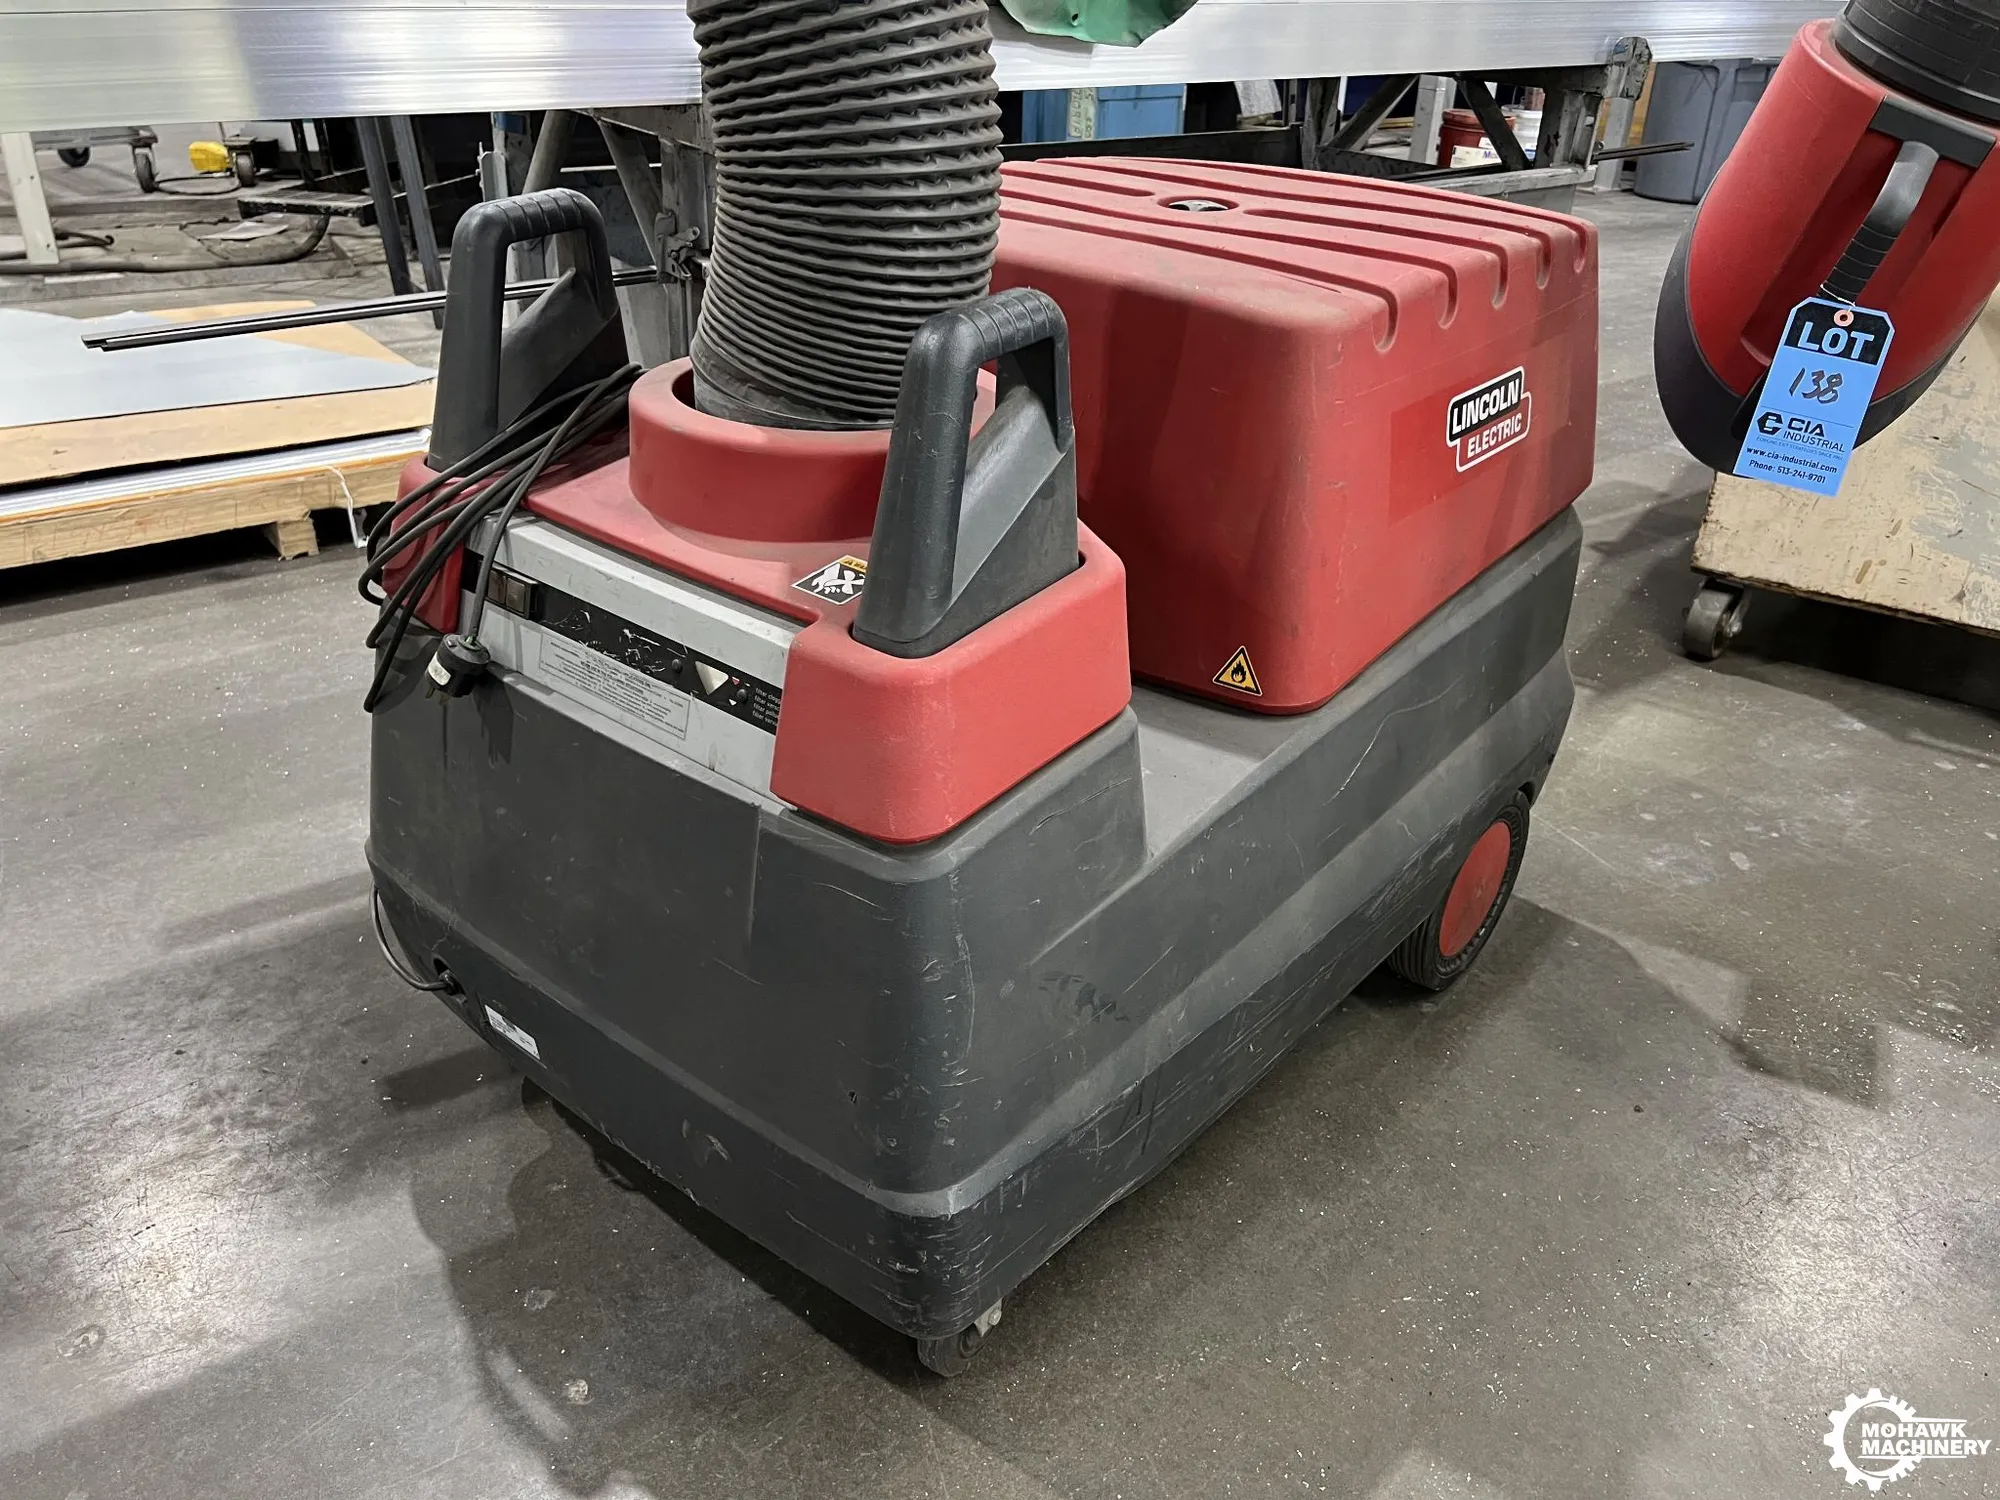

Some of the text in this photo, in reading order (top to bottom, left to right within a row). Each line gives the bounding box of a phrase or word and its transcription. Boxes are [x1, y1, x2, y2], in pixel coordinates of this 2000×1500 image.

[1798, 321, 1874, 359] LOT
[1789, 367, 1843, 404] 138
[1452, 378, 1520, 435] LINCOLN
[1467, 412, 1522, 458] ELECTRIC
[1783, 430, 1846, 453] INDUSTRIAL
[1788, 417, 1825, 437] CIA
[1746, 447, 1837, 473] www.cia-industrial.com
[1748, 459, 1826, 483] Phone: 513-241-9701
